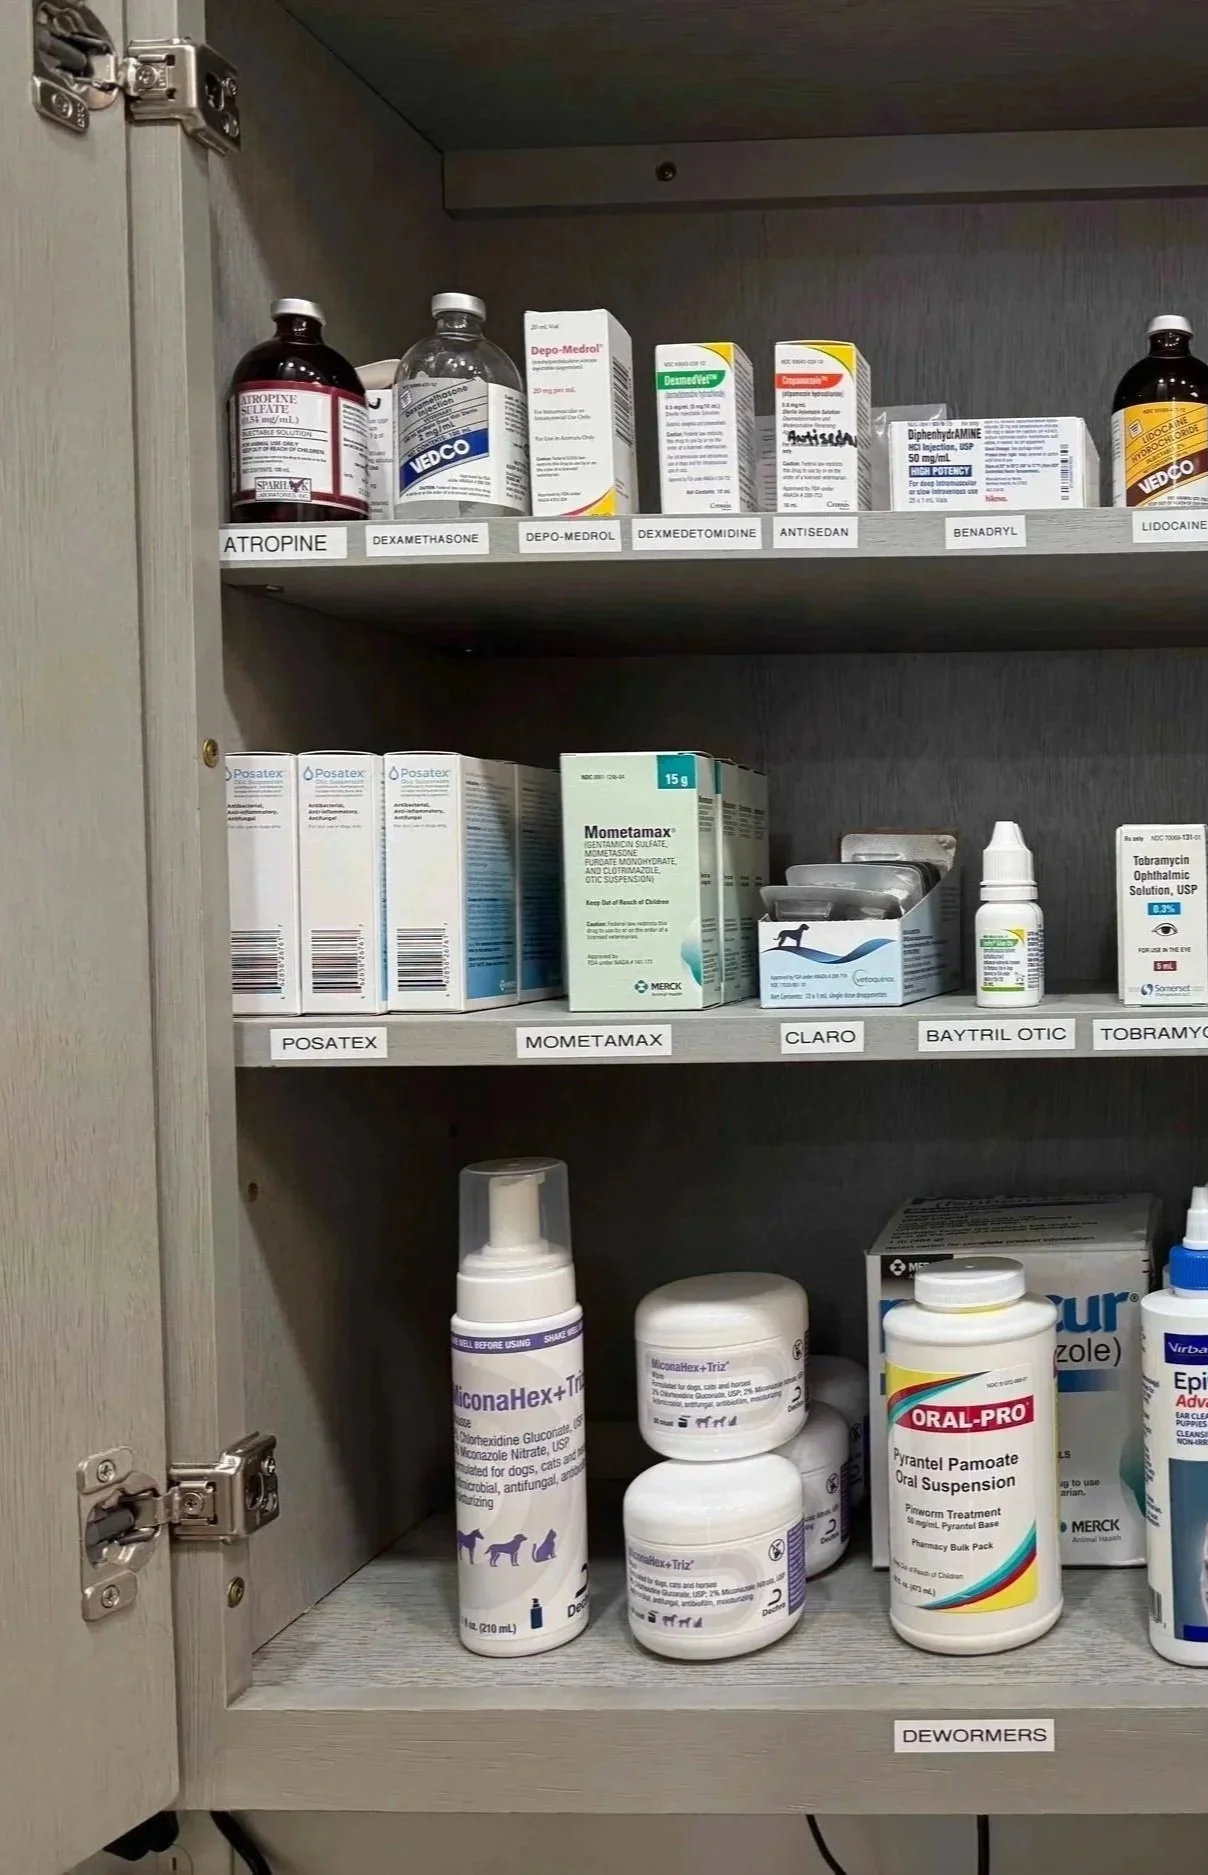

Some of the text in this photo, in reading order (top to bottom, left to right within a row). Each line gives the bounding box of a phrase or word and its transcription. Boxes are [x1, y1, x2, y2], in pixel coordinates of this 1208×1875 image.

[531, 344, 600, 357] Depo-Medrol
[242, 395, 298, 404] ATROPINE
[405, 386, 468, 418] Dexamethasone
[242, 404, 288, 414] SULFATE
[418, 398, 454, 417] Injection
[908, 428, 982, 441] DiphenhydrAMINE
[1142, 416, 1189, 444] LIDOCAINE
[1132, 424, 1200, 464] HYDROCHLORIDE
[410, 439, 470, 474] VEDCO
[908, 453, 951, 464] 50 mg/mL
[910, 467, 970, 476] HIGH POTENCY
[1138, 460, 1194, 495] VEDCO
[780, 527, 849, 537] ANTISEDAN
[954, 527, 1018, 537] BENADRYL
[1142, 521, 1208, 531] LIDOCAINE
[373, 533, 479, 545] DEXAMETHASONE
[526, 531, 615, 542] DEPO-MEDROL
[638, 528, 757, 539] DEXMEDETOMIDINE
[224, 535, 327, 552] ATROPINE
[233, 767, 282, 779] Posatex
[315, 767, 364, 779] Posatex
[401, 767, 450, 779] Posatex
[666, 774, 688, 787] 15 g
[584, 826, 671, 838] Mometamax
[635, 840, 668, 849] SULFATE,
[585, 849, 637, 857] MOMETASONE
[1133, 856, 1190, 868] Tobramycin
[1134, 870, 1190, 882] Ophthalmic
[1129, 885, 1198, 897] Solution, USP
[1153, 905, 1175, 913] 0.3%
[651, 982, 682, 990] MERCK
[1155, 984, 1190, 992] Somerset
[785, 1030, 856, 1044] CLARO
[926, 1027, 1066, 1042] BAYTRIL OTIC
[282, 1037, 377, 1051] POSATEX
[526, 1033, 663, 1049] MOMETAMAX
[912, 1403, 1026, 1430] ORAL-PRO
[894, 1447, 1019, 1472] Pyrantel Pamoate
[896, 1469, 1016, 1496] Oral Suspension
[905, 1503, 1001, 1520] Pinworm Treatment
[1072, 1519, 1120, 1533] MERCK
[911, 1538, 993, 1553] Pharmacy Bulk Pack
[762, 1602, 786, 1616] Dechra
[903, 1728, 1047, 1743] DEWORMERS
